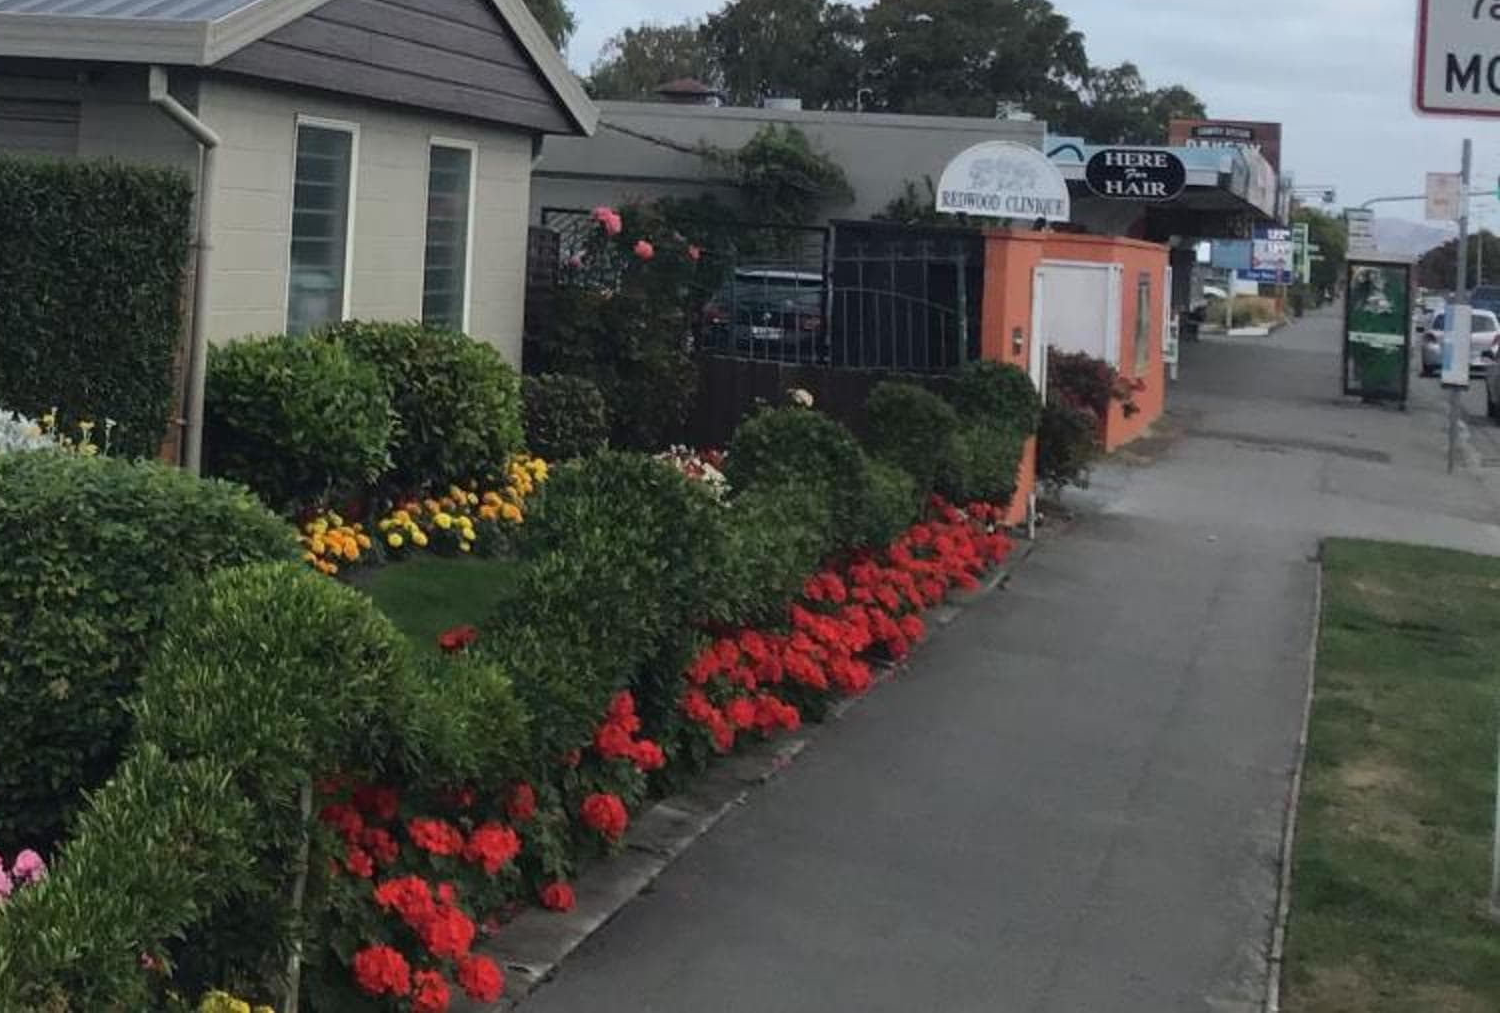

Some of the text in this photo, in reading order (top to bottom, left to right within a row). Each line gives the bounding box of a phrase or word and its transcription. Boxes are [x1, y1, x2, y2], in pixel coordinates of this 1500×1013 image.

[1105, 152, 1168, 168] HERE
[1105, 180, 1169, 196] HAIR
[941, 190, 1001, 210] REDWOOD
